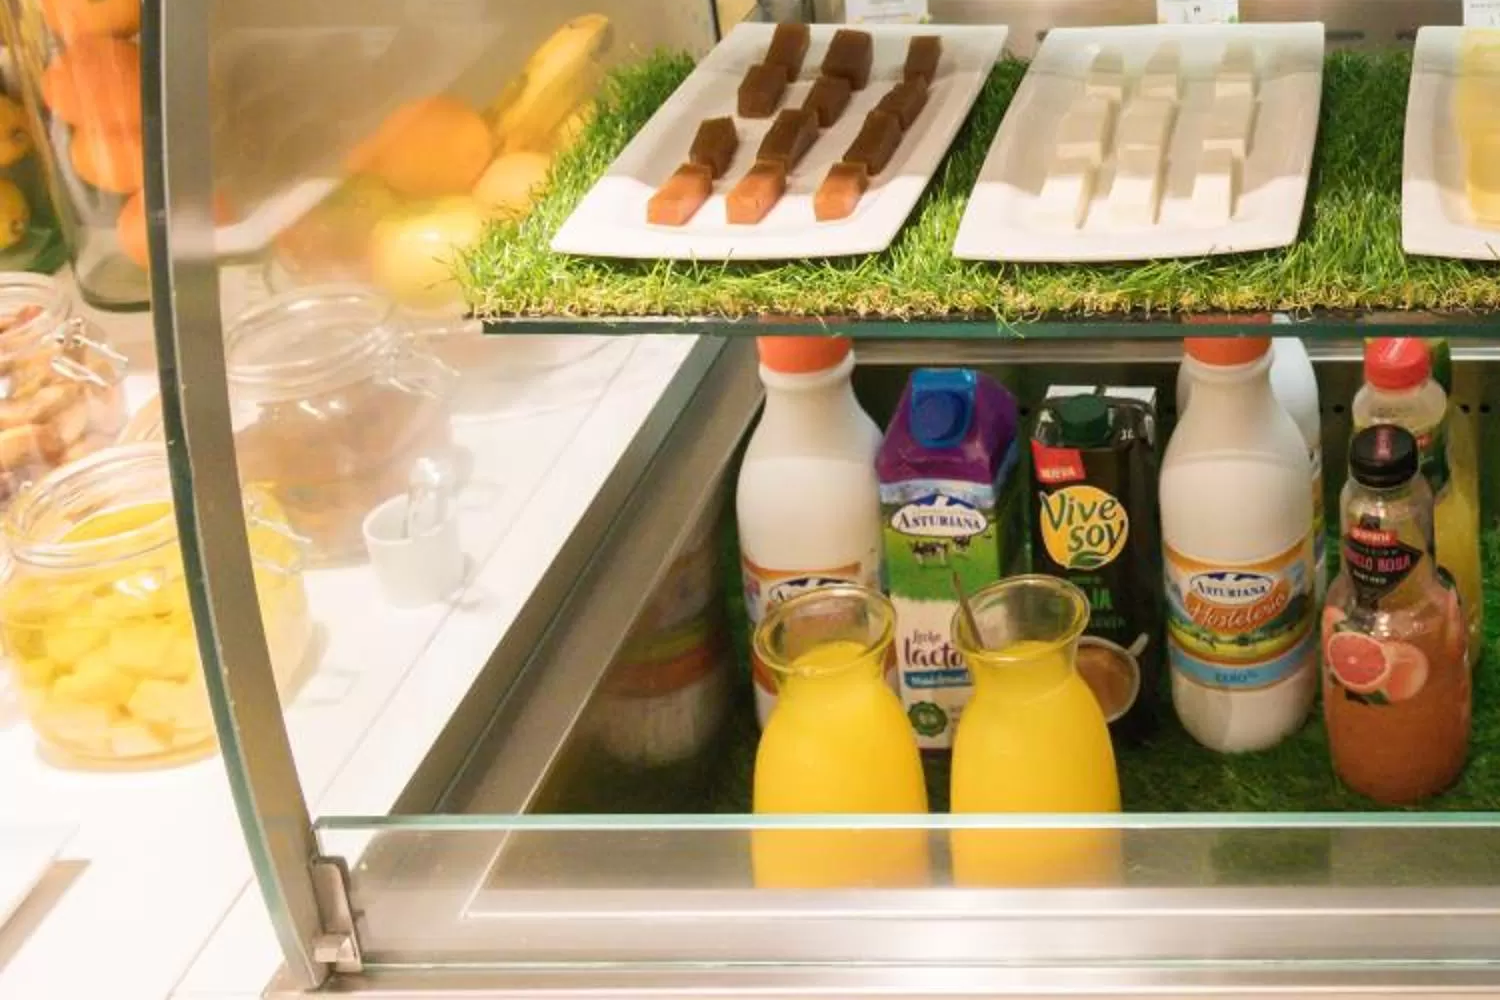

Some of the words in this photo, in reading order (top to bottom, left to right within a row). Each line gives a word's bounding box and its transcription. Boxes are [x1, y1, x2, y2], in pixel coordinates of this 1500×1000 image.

[898, 511, 981, 530] ASTURIANA
[1040, 490, 1117, 531] Vive
[1068, 519, 1125, 556] soy
[1194, 581, 1267, 598] ASTURIANA
[904, 636, 963, 670] lacto
